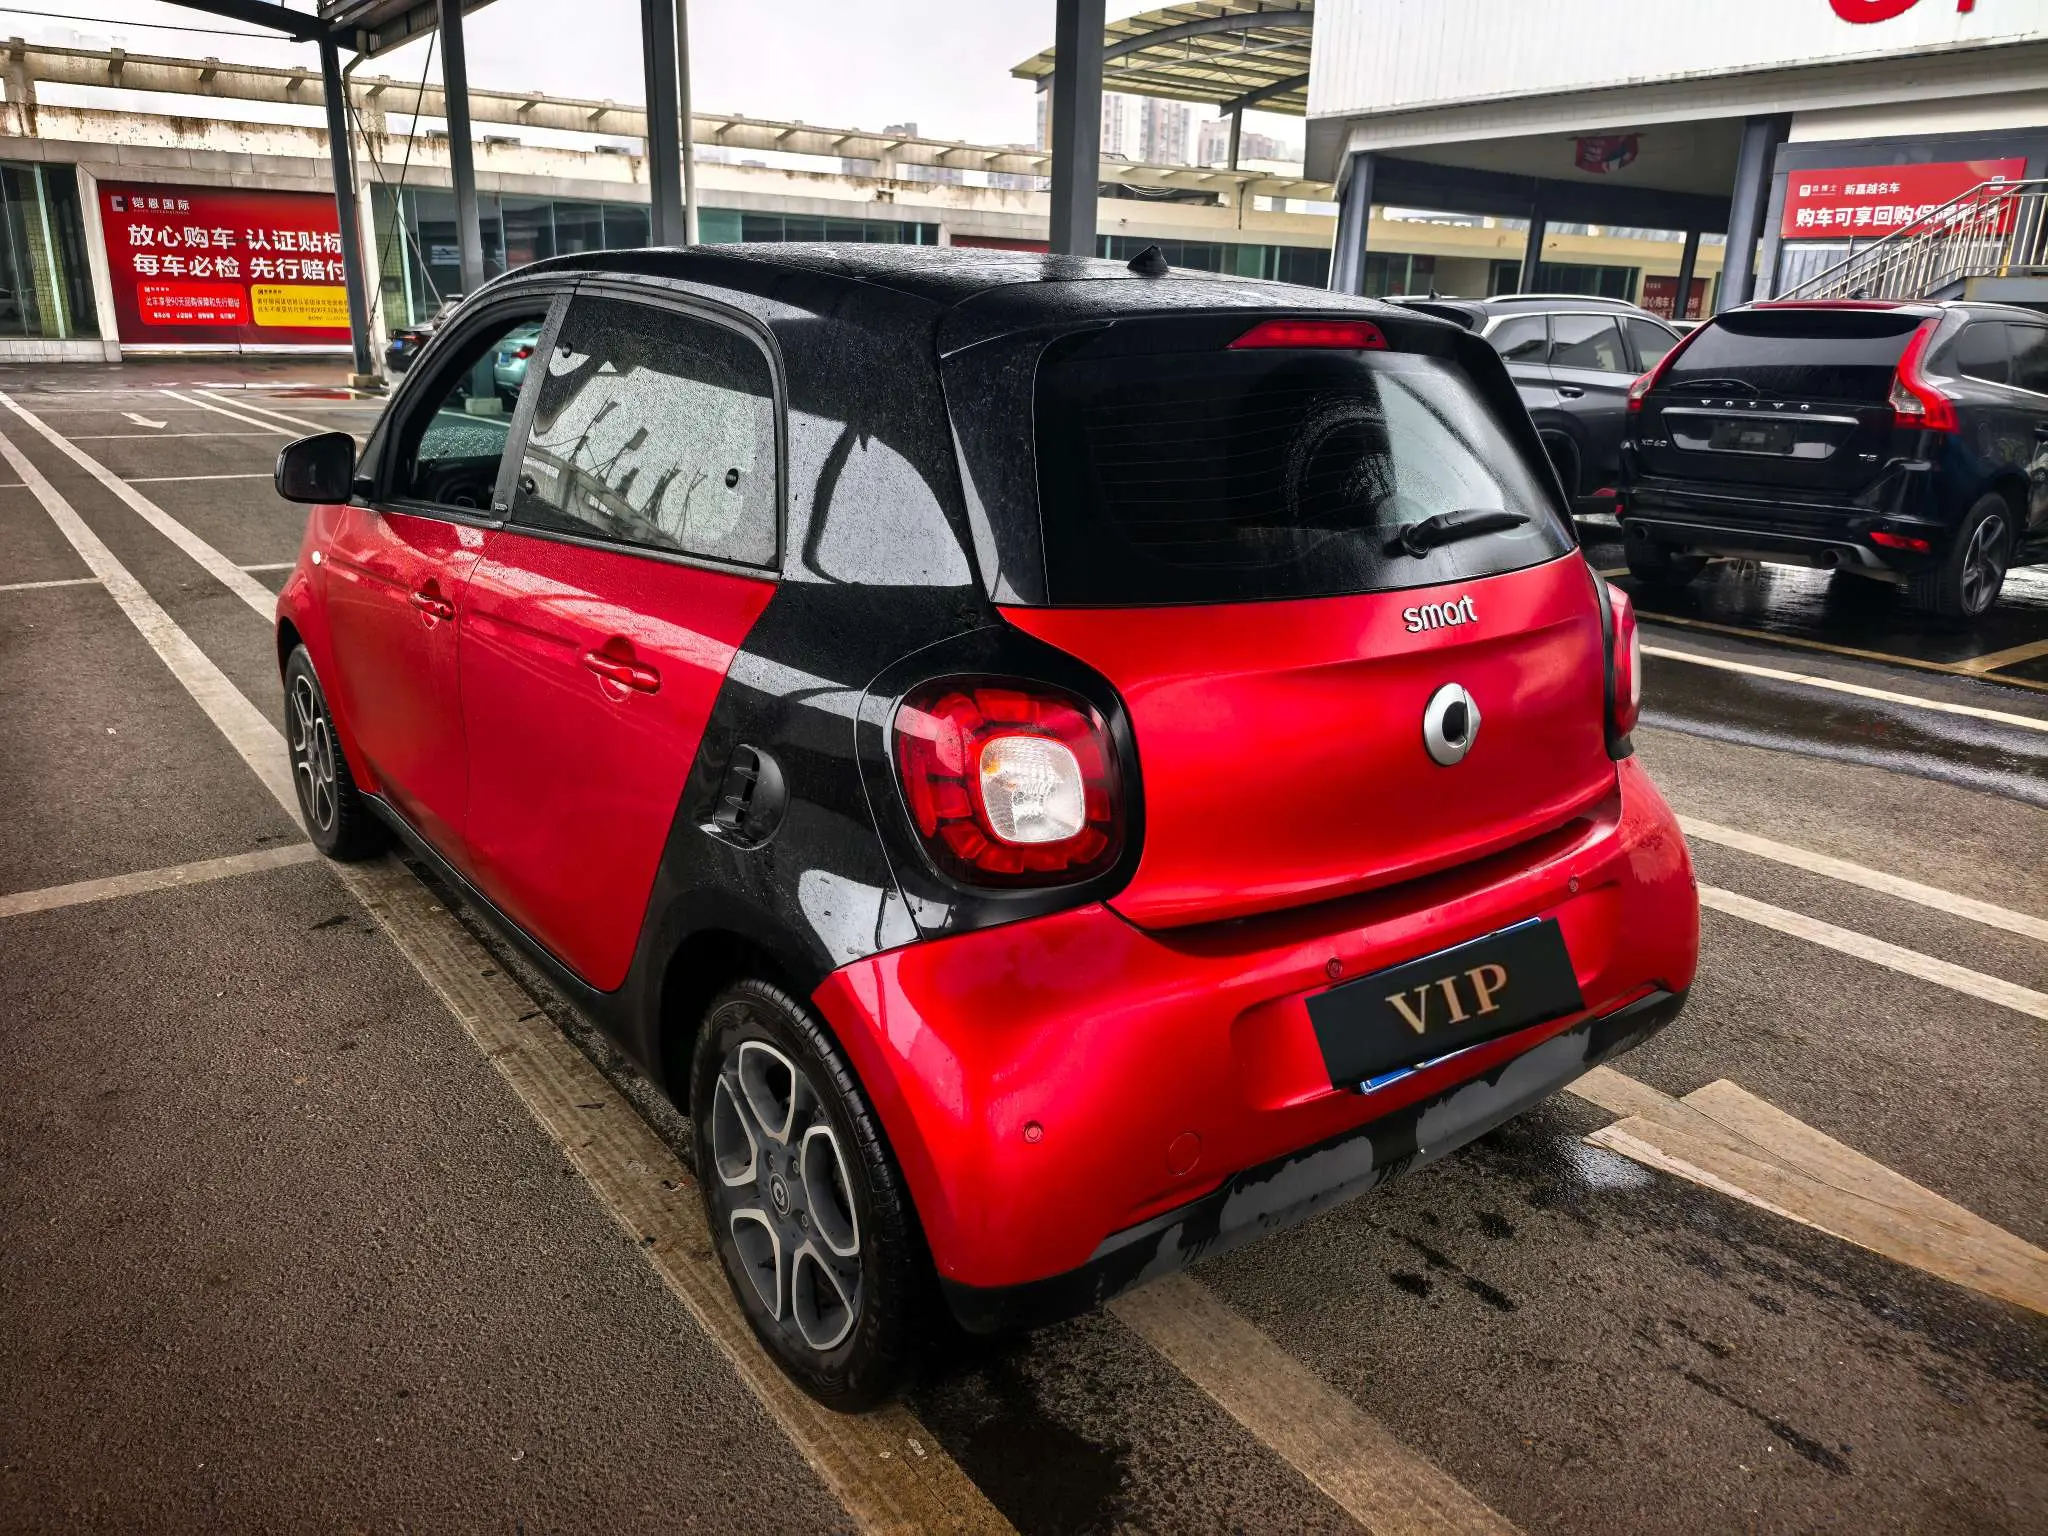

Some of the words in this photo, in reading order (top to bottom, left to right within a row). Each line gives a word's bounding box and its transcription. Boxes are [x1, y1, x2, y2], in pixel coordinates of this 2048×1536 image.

[128, 224, 236, 249] 放心购车
[245, 228, 341, 253] 认证贴标
[133, 253, 240, 278] 每车必检
[249, 257, 345, 281] 先行赔付
[1700, 399, 1810, 410] VOLVO
[1641, 438, 1668, 447] XC60
[1402, 594, 1478, 633] smart
[1384, 963, 1507, 1035] VIP
